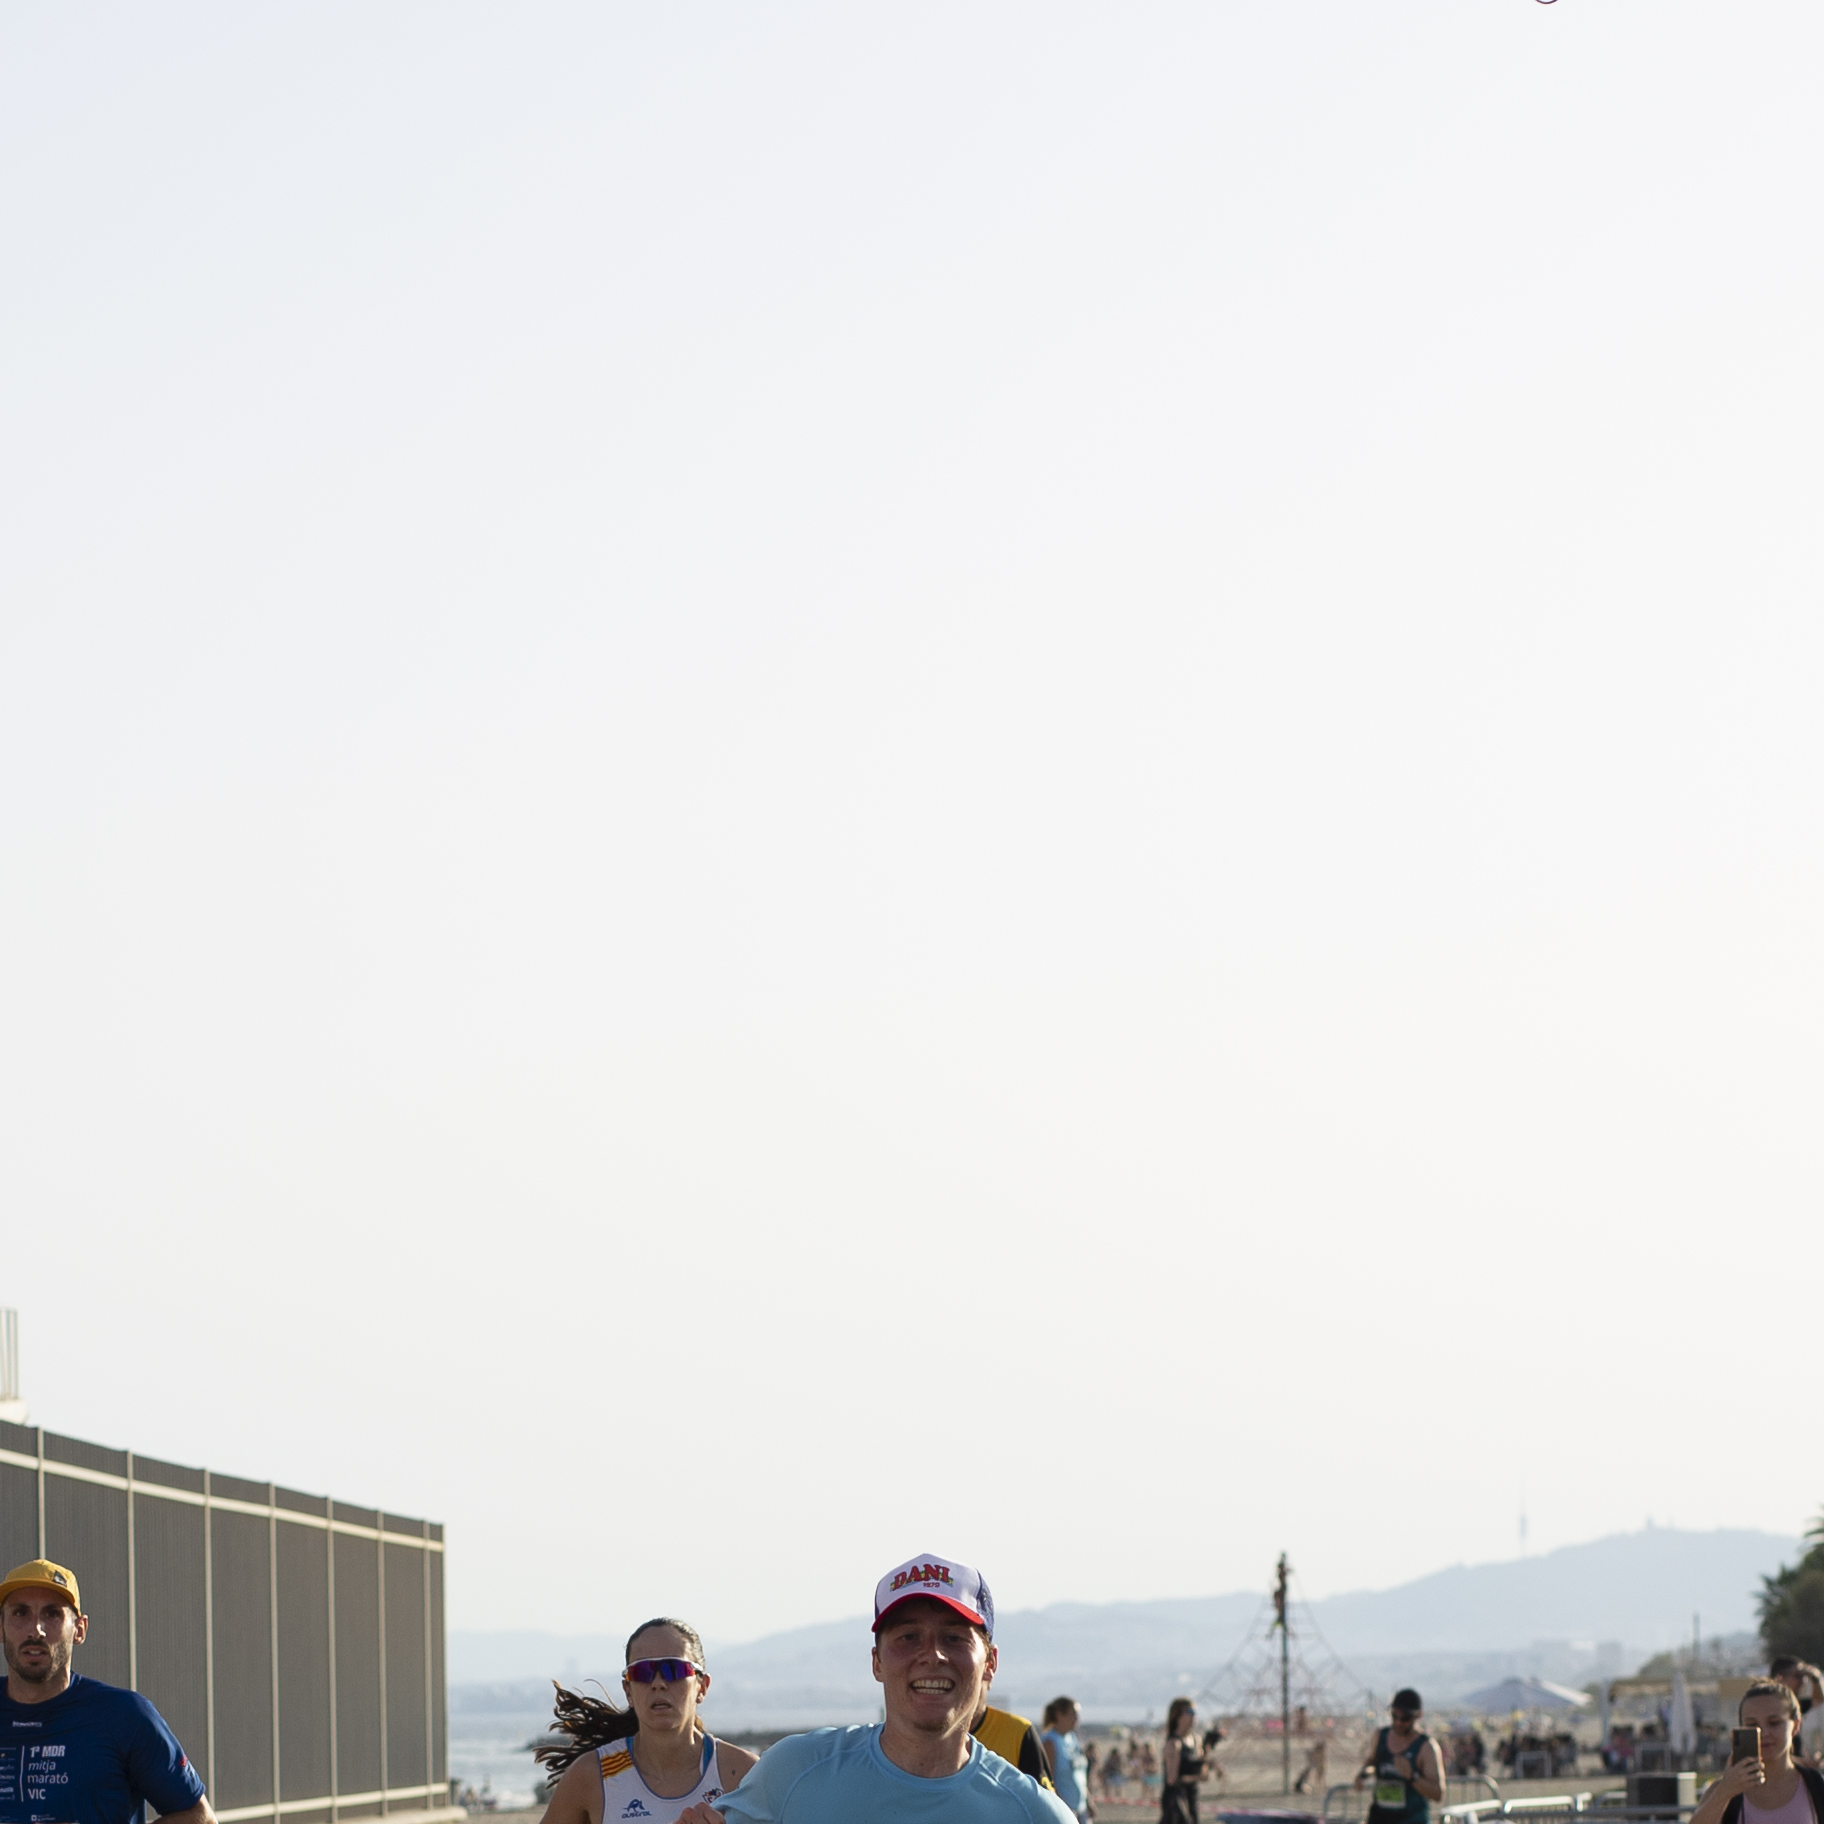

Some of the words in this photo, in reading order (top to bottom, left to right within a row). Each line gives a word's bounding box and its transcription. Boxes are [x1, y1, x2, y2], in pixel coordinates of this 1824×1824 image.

[892, 1563, 950, 1591] DANI
[41, 1745, 66, 1758] MDR
[28, 1759, 56, 1774] mitja
[27, 1771, 69, 1784] marató
[27, 1788, 46, 1800] VIC
